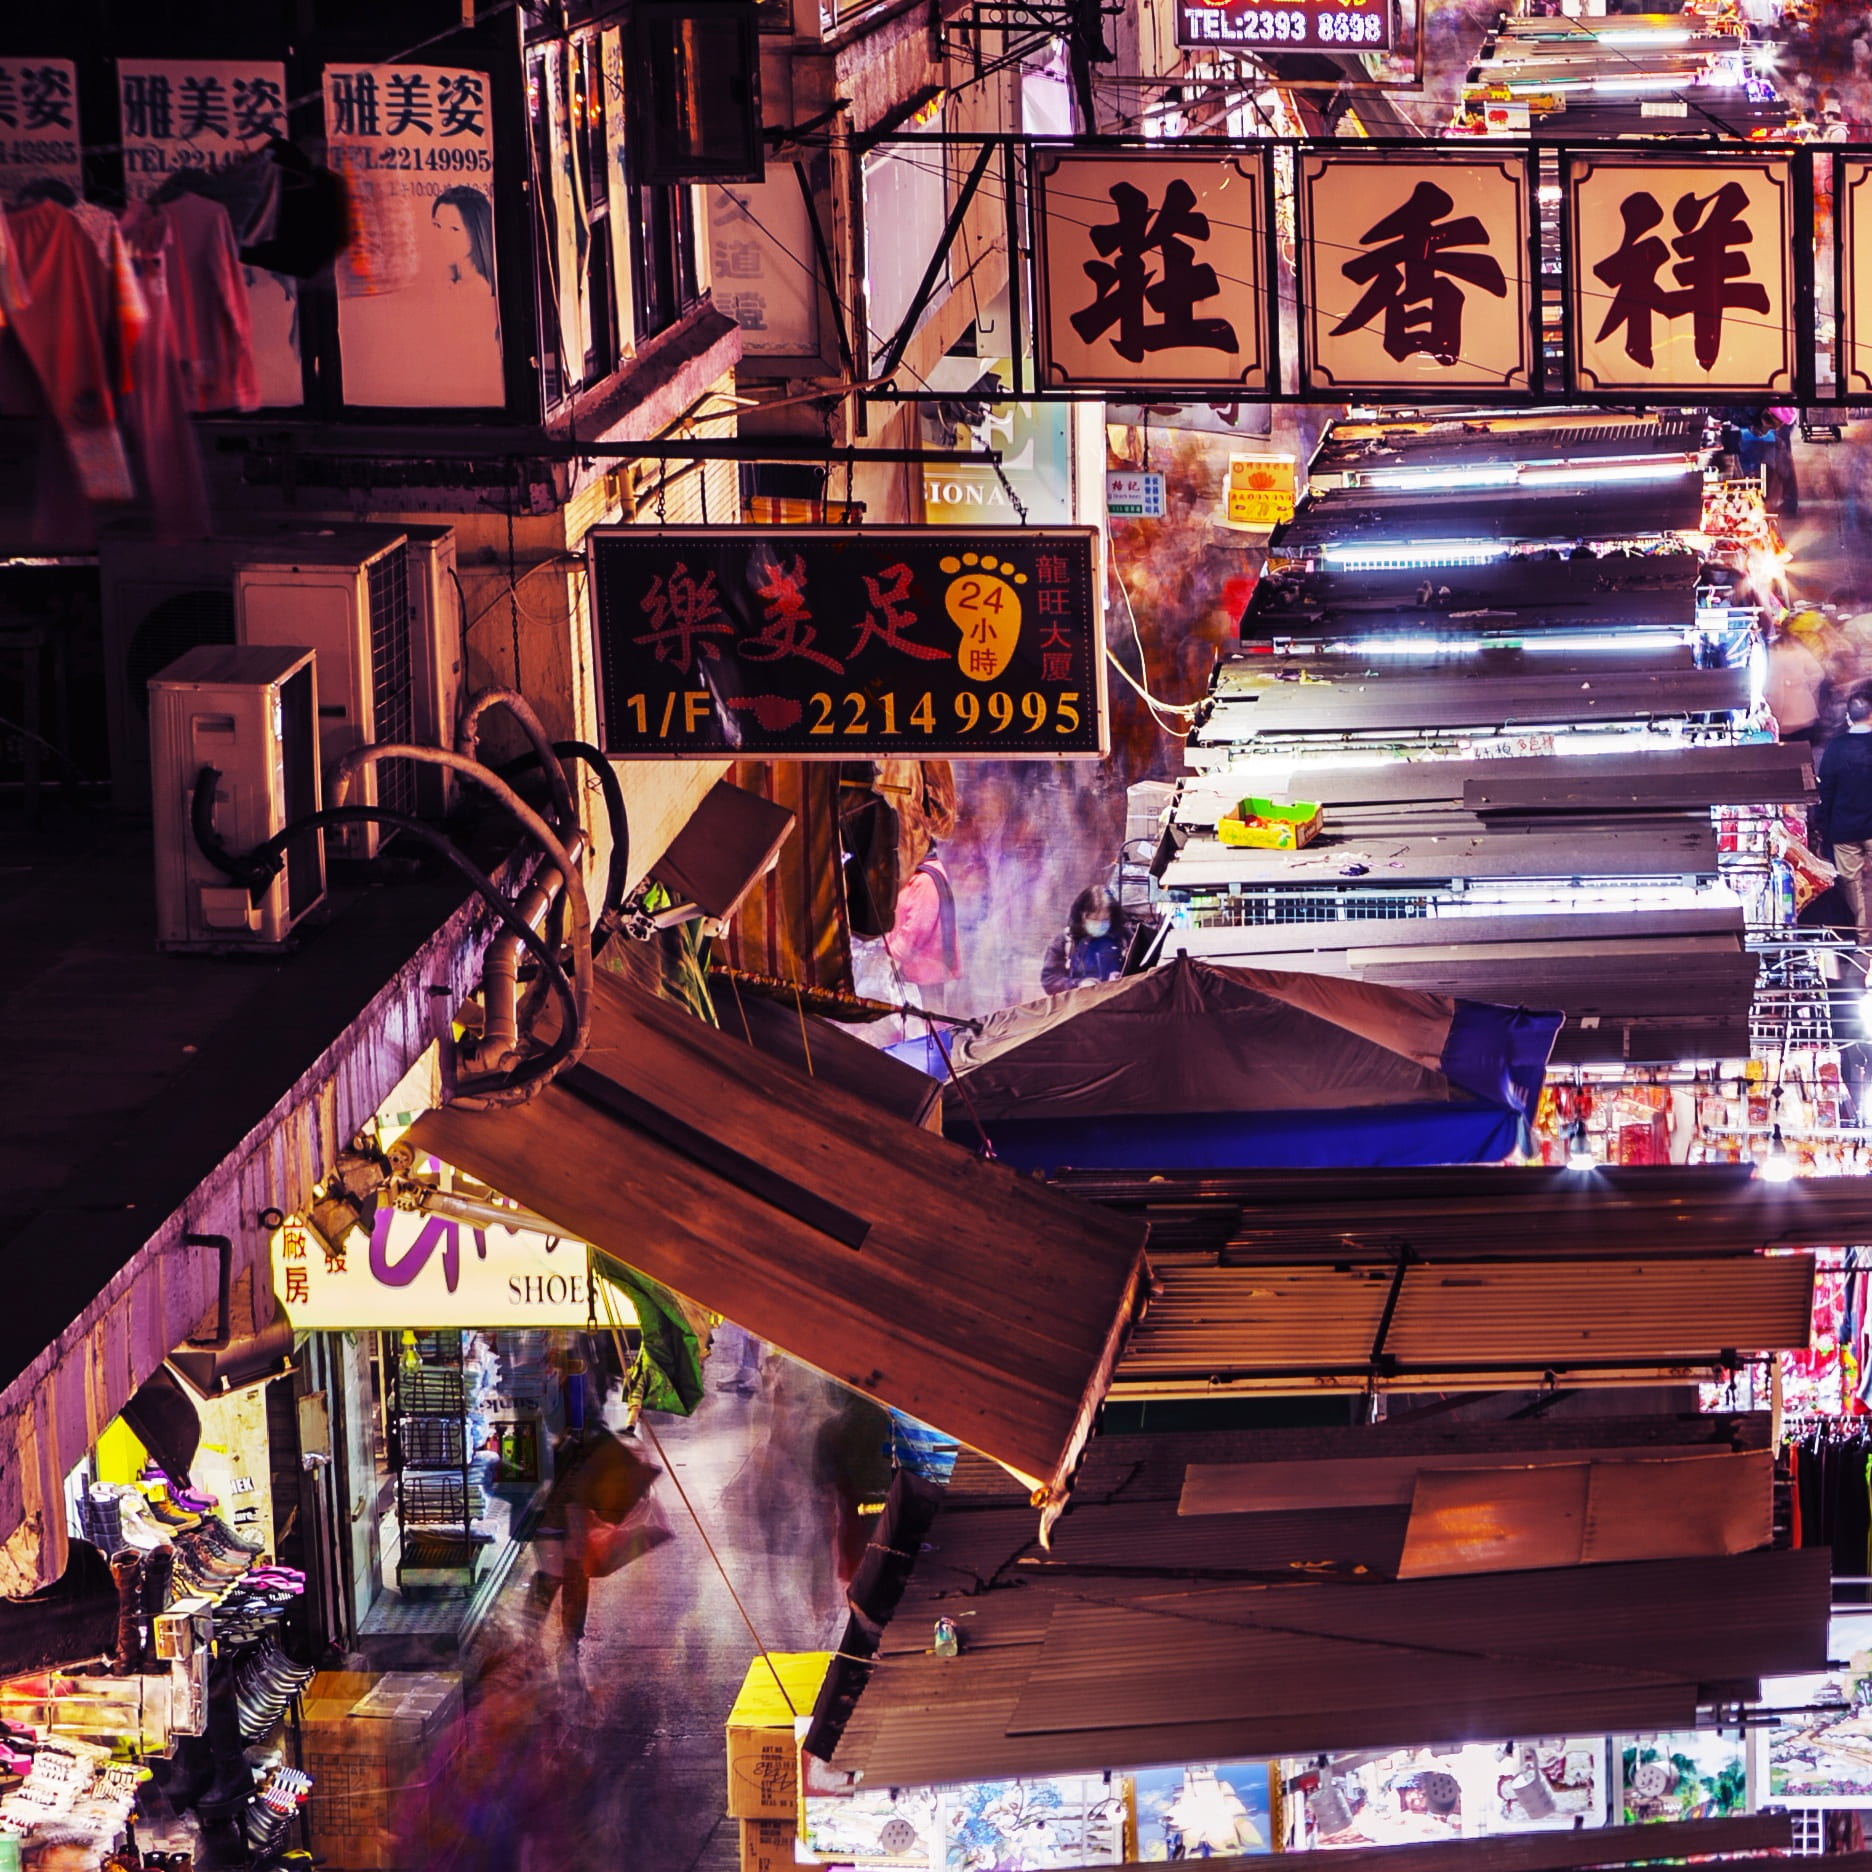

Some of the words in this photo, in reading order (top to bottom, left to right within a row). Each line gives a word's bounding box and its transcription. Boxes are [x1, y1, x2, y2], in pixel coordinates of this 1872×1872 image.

[123, 72, 286, 139] 雅美姿
[331, 72, 486, 137] 雅美姿
[959, 582, 1004, 613] 24
[1035, 555, 1073, 681] 龍旺大廈
[969, 618, 998, 676] 小時
[627, 692, 711, 737] 1/F
[809, 692, 937, 735] 2214
[954, 691, 1080, 734] 9995
